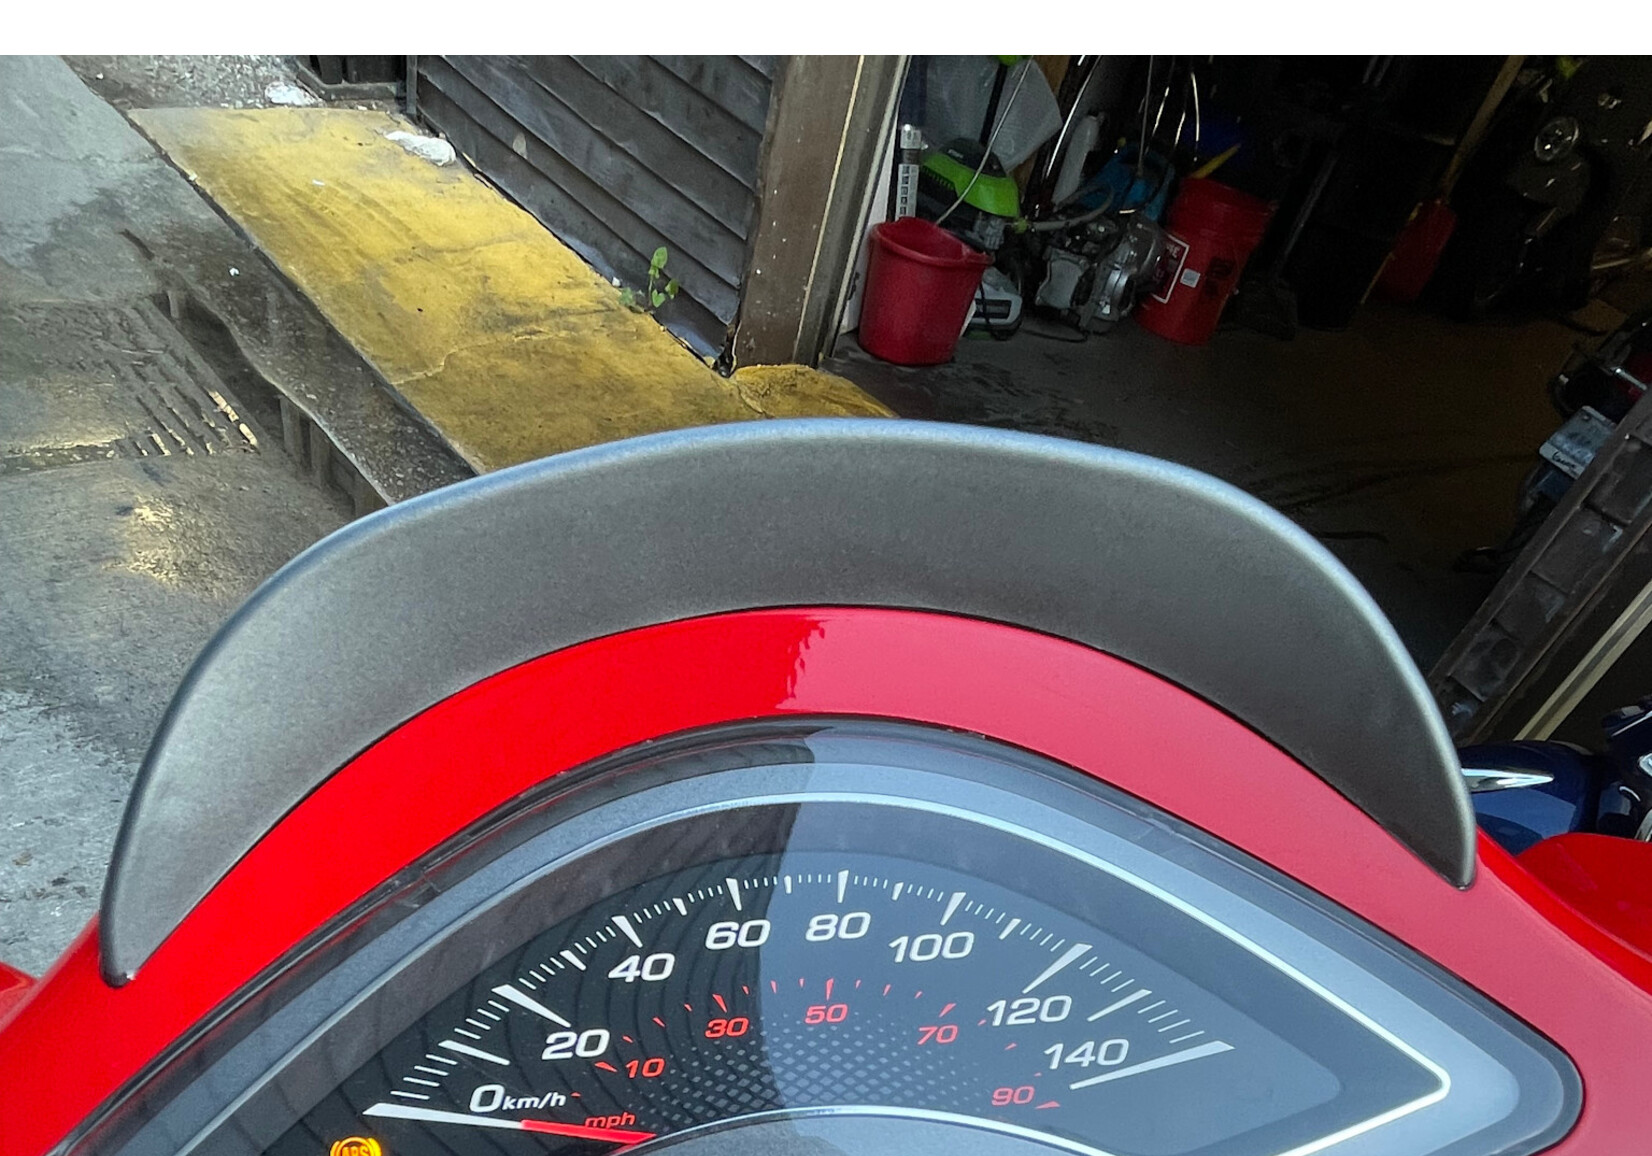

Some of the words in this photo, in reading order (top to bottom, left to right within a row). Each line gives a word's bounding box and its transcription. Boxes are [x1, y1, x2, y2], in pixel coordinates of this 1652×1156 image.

[704, 919, 771, 950] 60
[805, 911, 872, 942] 80
[889, 931, 975, 963] 100
[607, 952, 676, 982] 40
[804, 1003, 849, 1024] 50
[986, 995, 1073, 1027] 120
[704, 1017, 749, 1038] 30
[916, 1025, 958, 1045] 70
[541, 1028, 611, 1061] 20
[1043, 1038, 1130, 1070] 140
[625, 1057, 666, 1079] 10
[991, 1085, 1036, 1107] 90
[584, 1112, 636, 1130] mph
